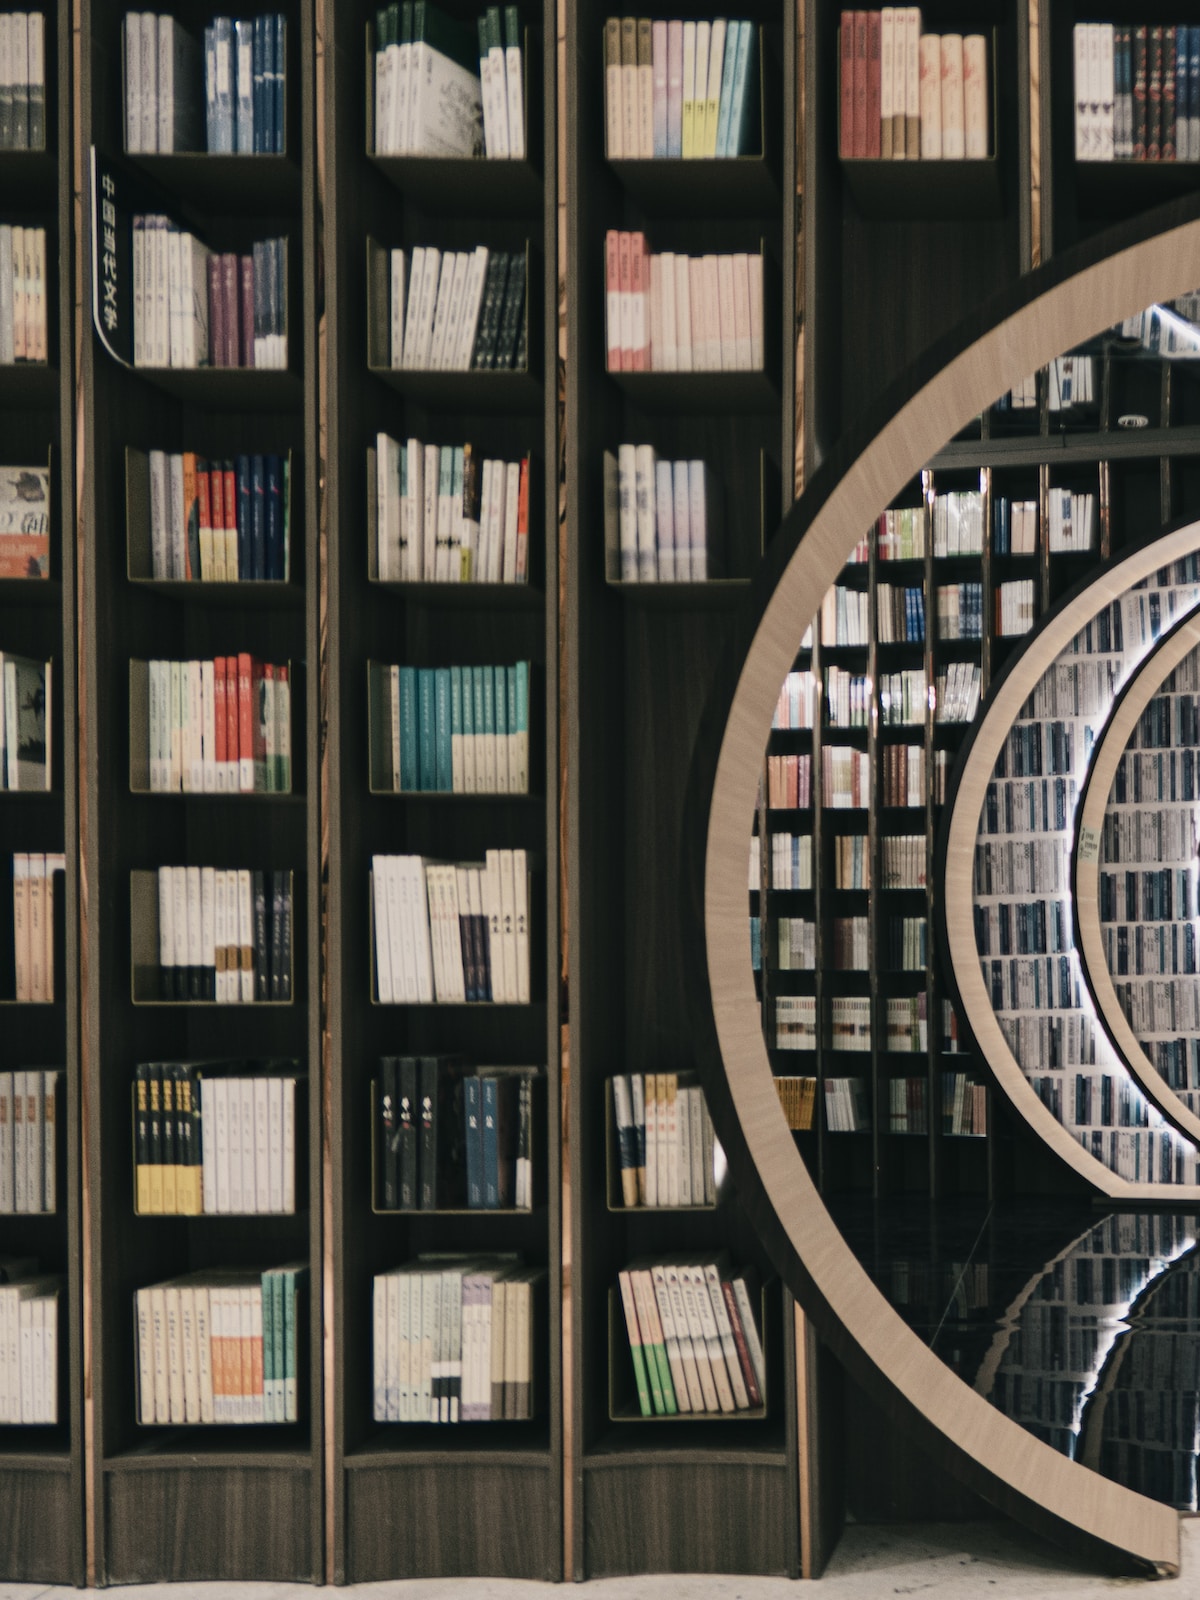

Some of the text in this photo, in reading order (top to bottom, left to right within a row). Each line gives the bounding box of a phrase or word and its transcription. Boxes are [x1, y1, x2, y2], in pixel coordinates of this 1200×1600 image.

[102, 173, 118, 330] 中国当代文学
